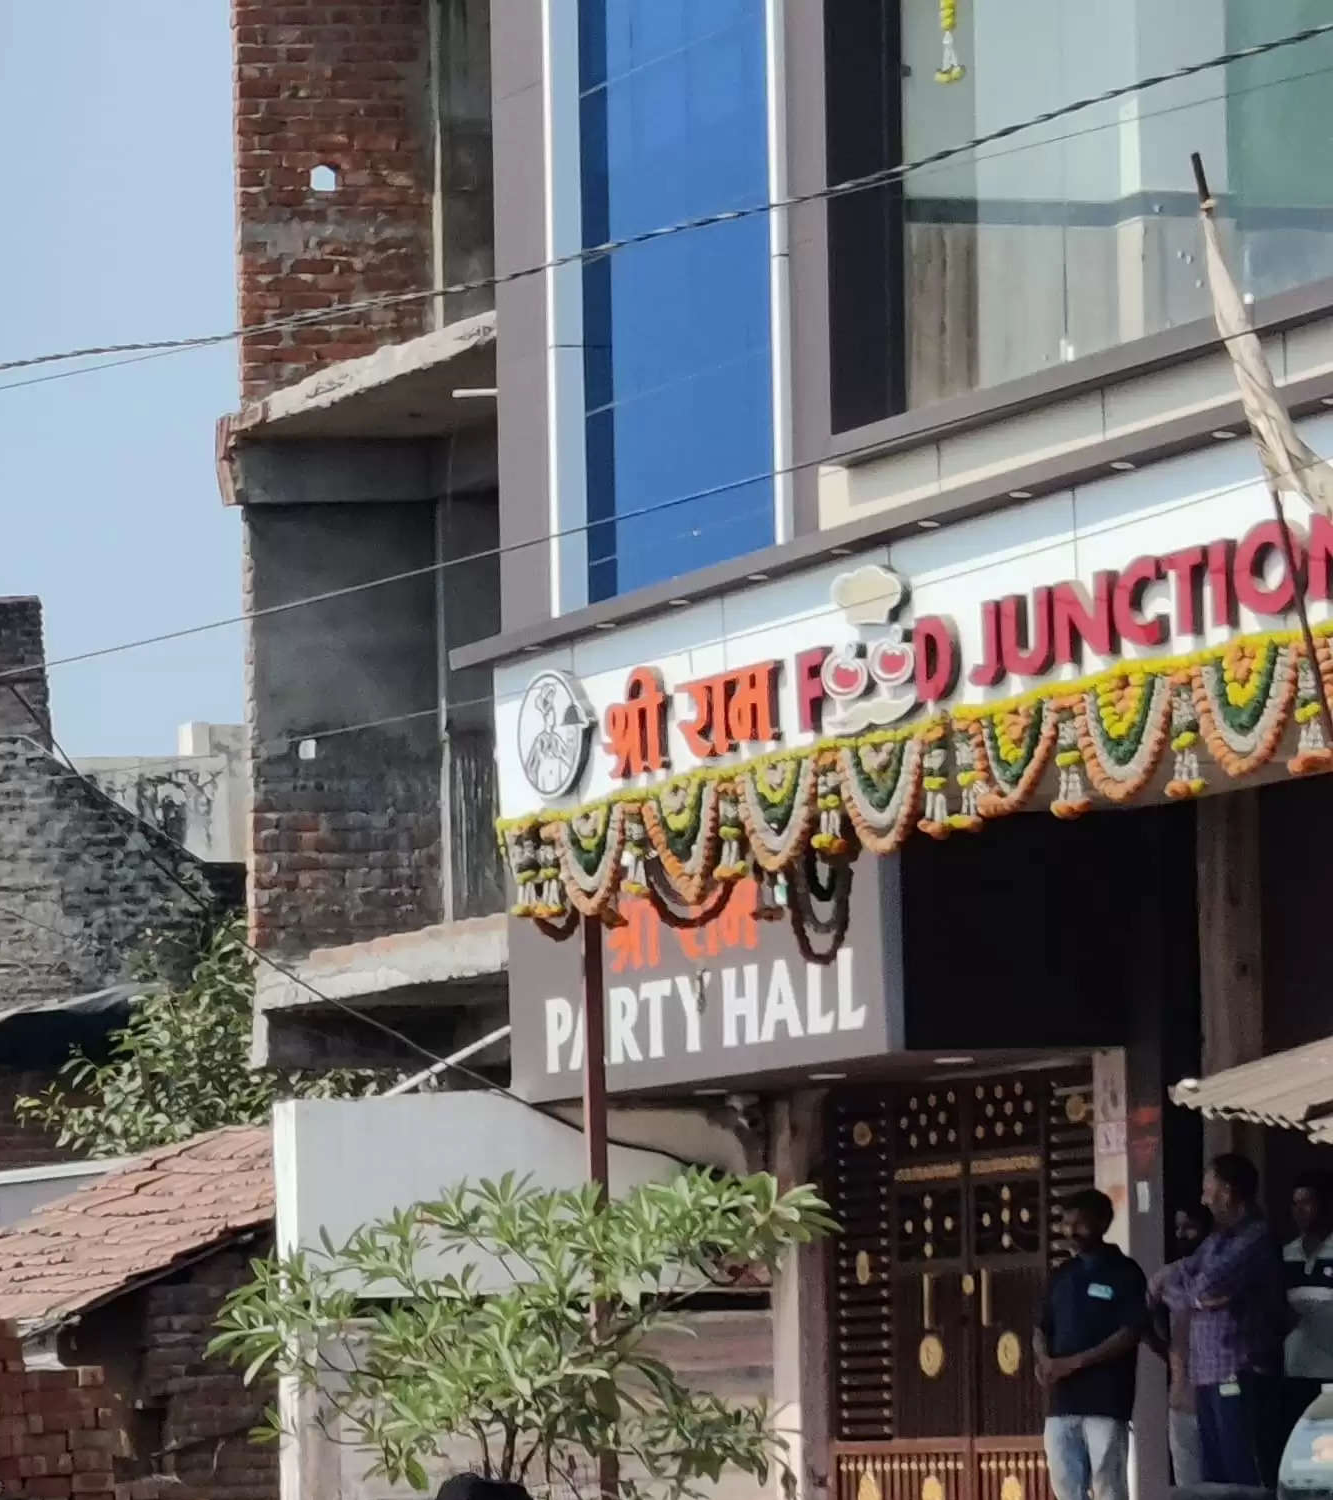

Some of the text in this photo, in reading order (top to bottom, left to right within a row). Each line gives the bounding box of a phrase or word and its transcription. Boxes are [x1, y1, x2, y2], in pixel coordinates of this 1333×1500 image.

[603, 666, 669, 780] श्री
[676, 660, 783, 758] राम
[720, 948, 867, 1048] HALL
